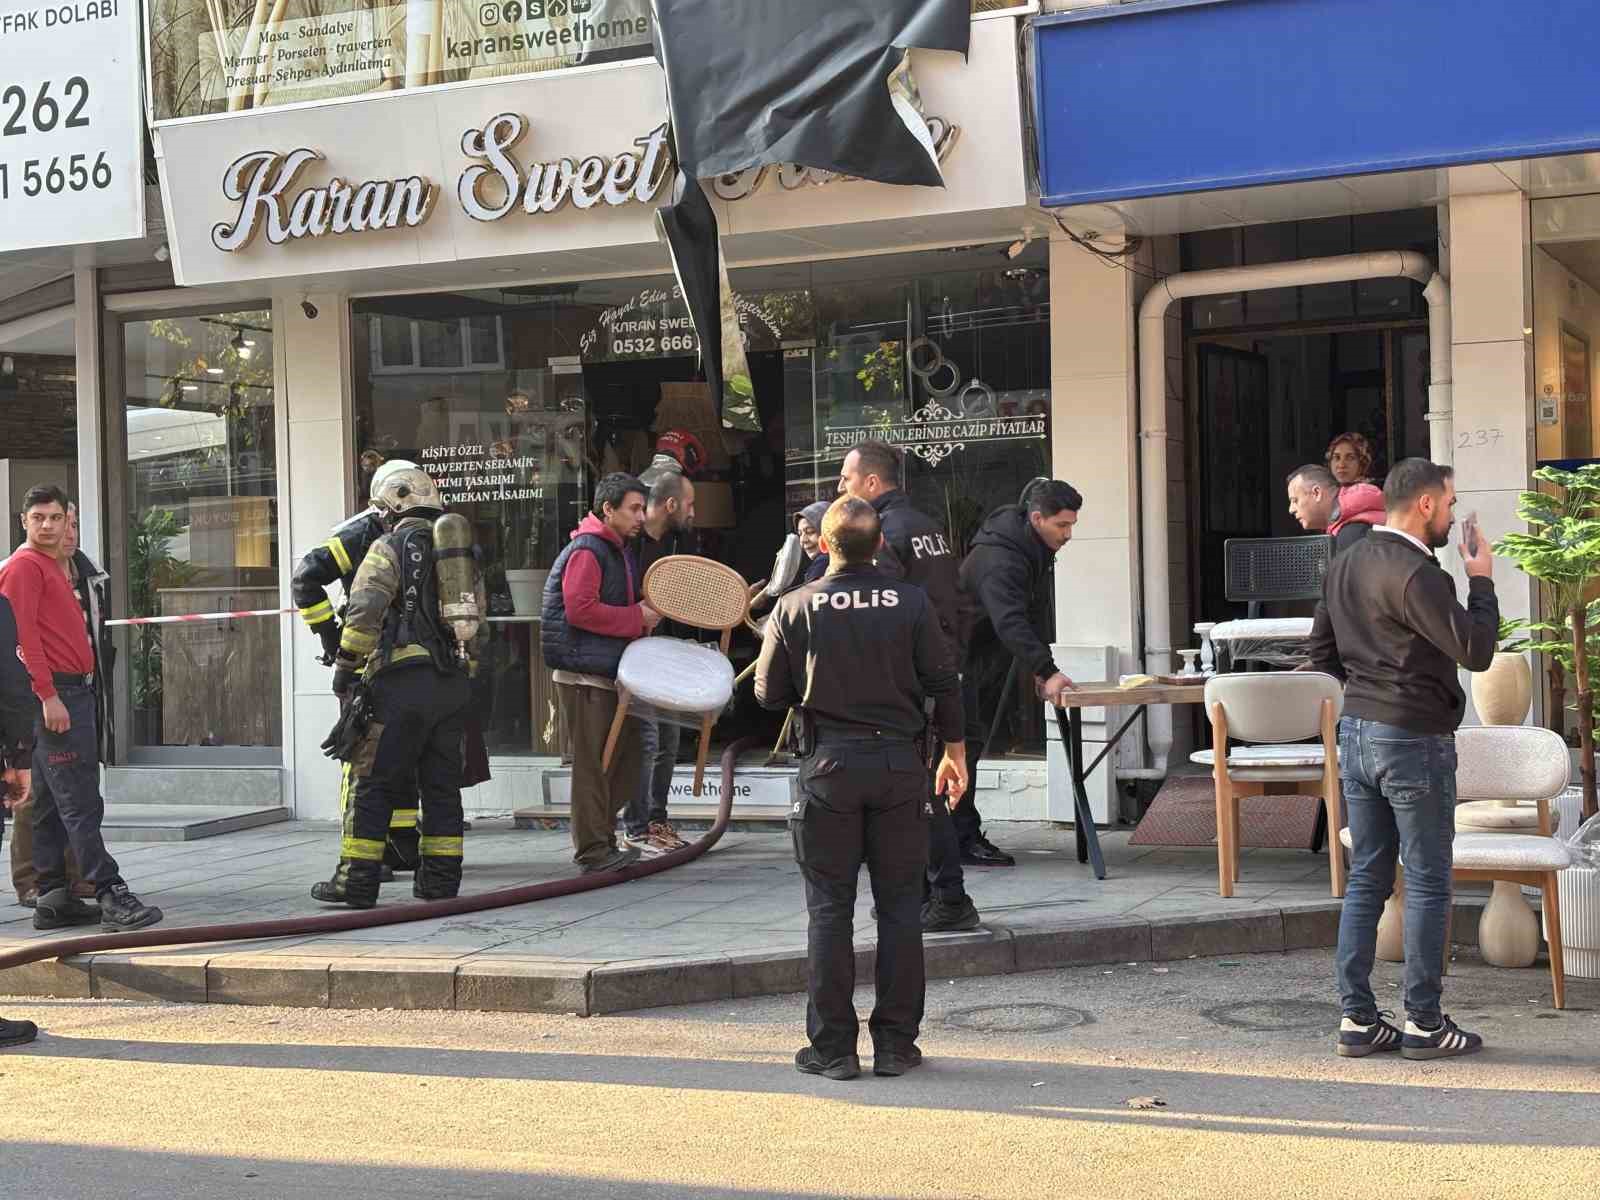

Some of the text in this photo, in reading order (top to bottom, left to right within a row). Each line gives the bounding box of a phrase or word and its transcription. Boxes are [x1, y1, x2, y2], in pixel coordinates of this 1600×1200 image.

[0, 0, 118, 33] FAK DOLABI
[258, 31, 289, 45] Masa
[298, 21, 353, 39] Sandalye
[446, 16, 648, 59] karansweethome
[224, 53, 268, 69] Mermer
[278, 46, 327, 62] Porselen
[336, 37, 392, 54] traverten
[2, 75, 90, 136] 262
[23, 151, 112, 197] 5656
[211, 148, 441, 253] Karan
[457, 112, 672, 223] Sweet
[640, 288, 667, 307] Edin
[611, 320, 656, 333] KARAN
[613, 335, 693, 354] 0532 666
[952, 421, 986, 437] CAZİP
[989, 419, 1045, 436] FİYATLAR
[1457, 428, 1504, 449] 237
[421, 445, 484, 460] KİŞİYE ÖZEL
[422, 455, 534, 473] TRAVERTEN SERAMİK
[465, 473, 515, 486] TASARIMI
[452, 490, 490, 503] MEKAN
[491, 487, 543, 500] TASARIMI
